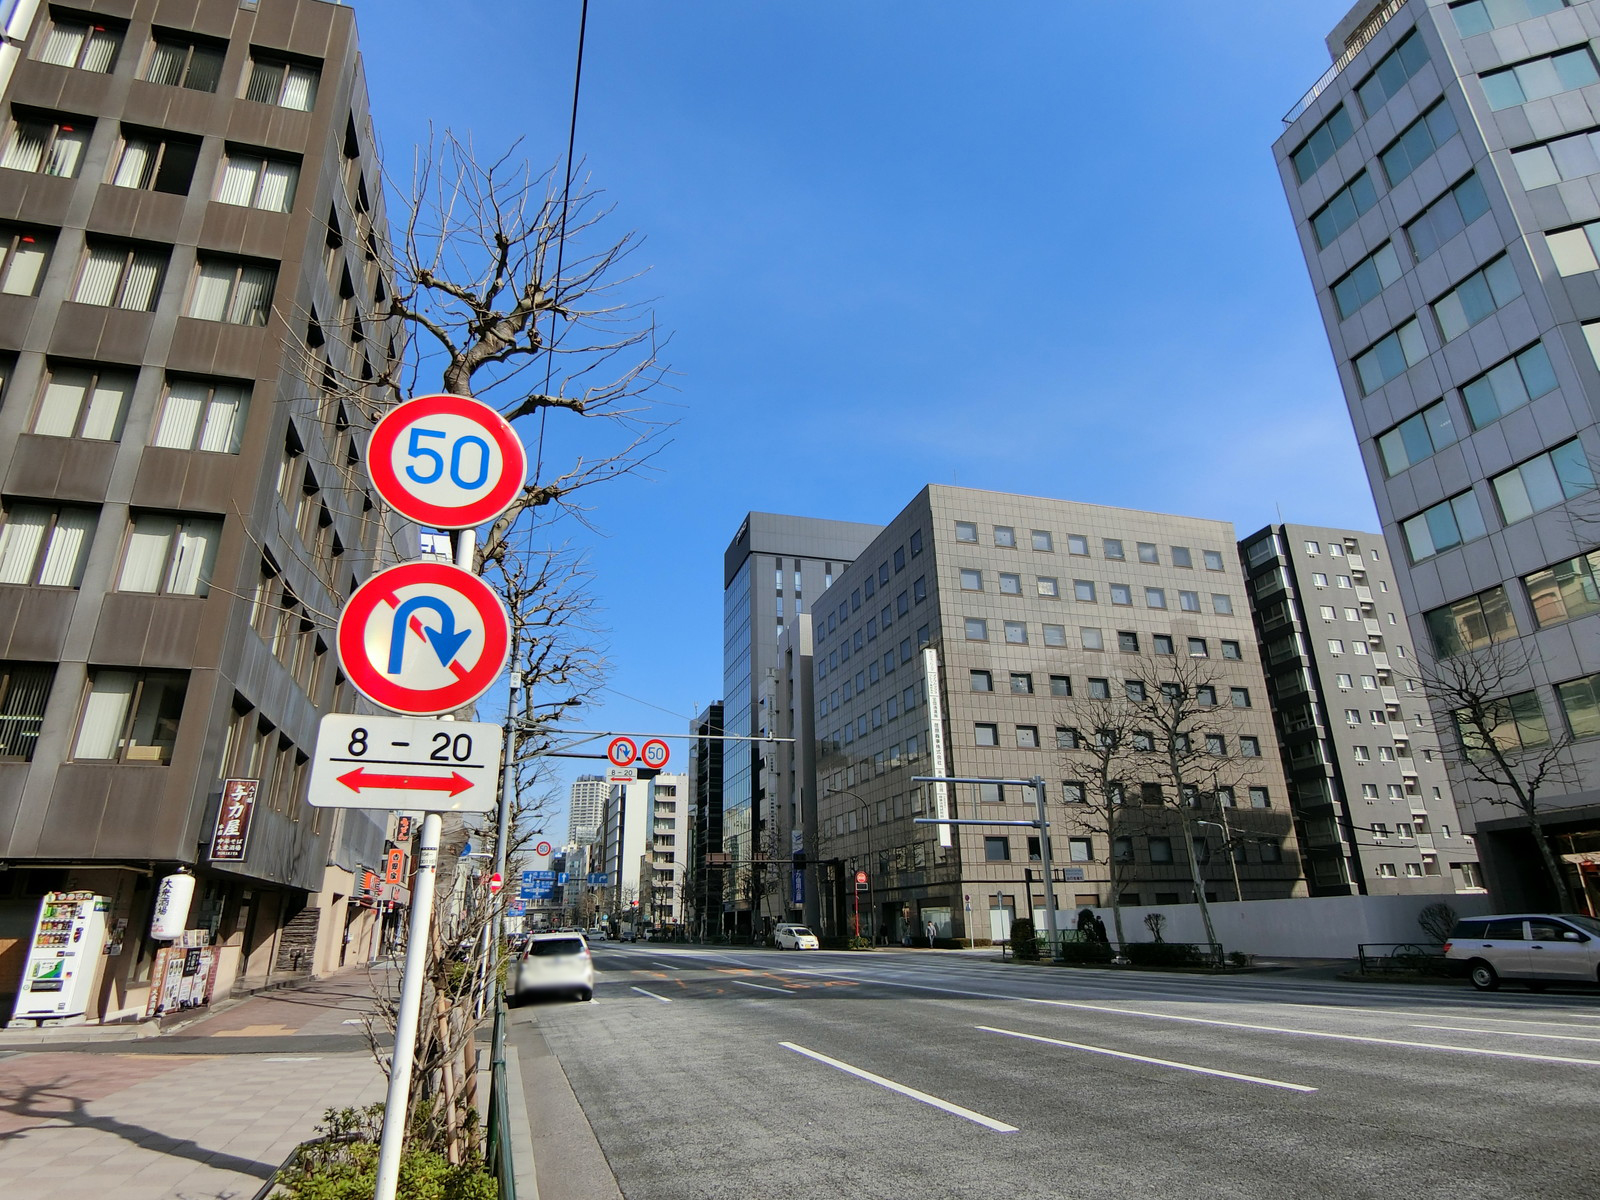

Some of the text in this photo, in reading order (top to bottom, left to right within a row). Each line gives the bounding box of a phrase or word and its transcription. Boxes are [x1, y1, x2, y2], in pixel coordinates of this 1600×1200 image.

[405, 427, 490, 490] 50
[348, 727, 369, 757] 8
[430, 732, 473, 762] 20
[647, 746, 664, 761] 50
[223, 784, 248, 836] 与力屋
[539, 845, 548, 853] 50
[158, 878, 174, 916] 大衆酒場
